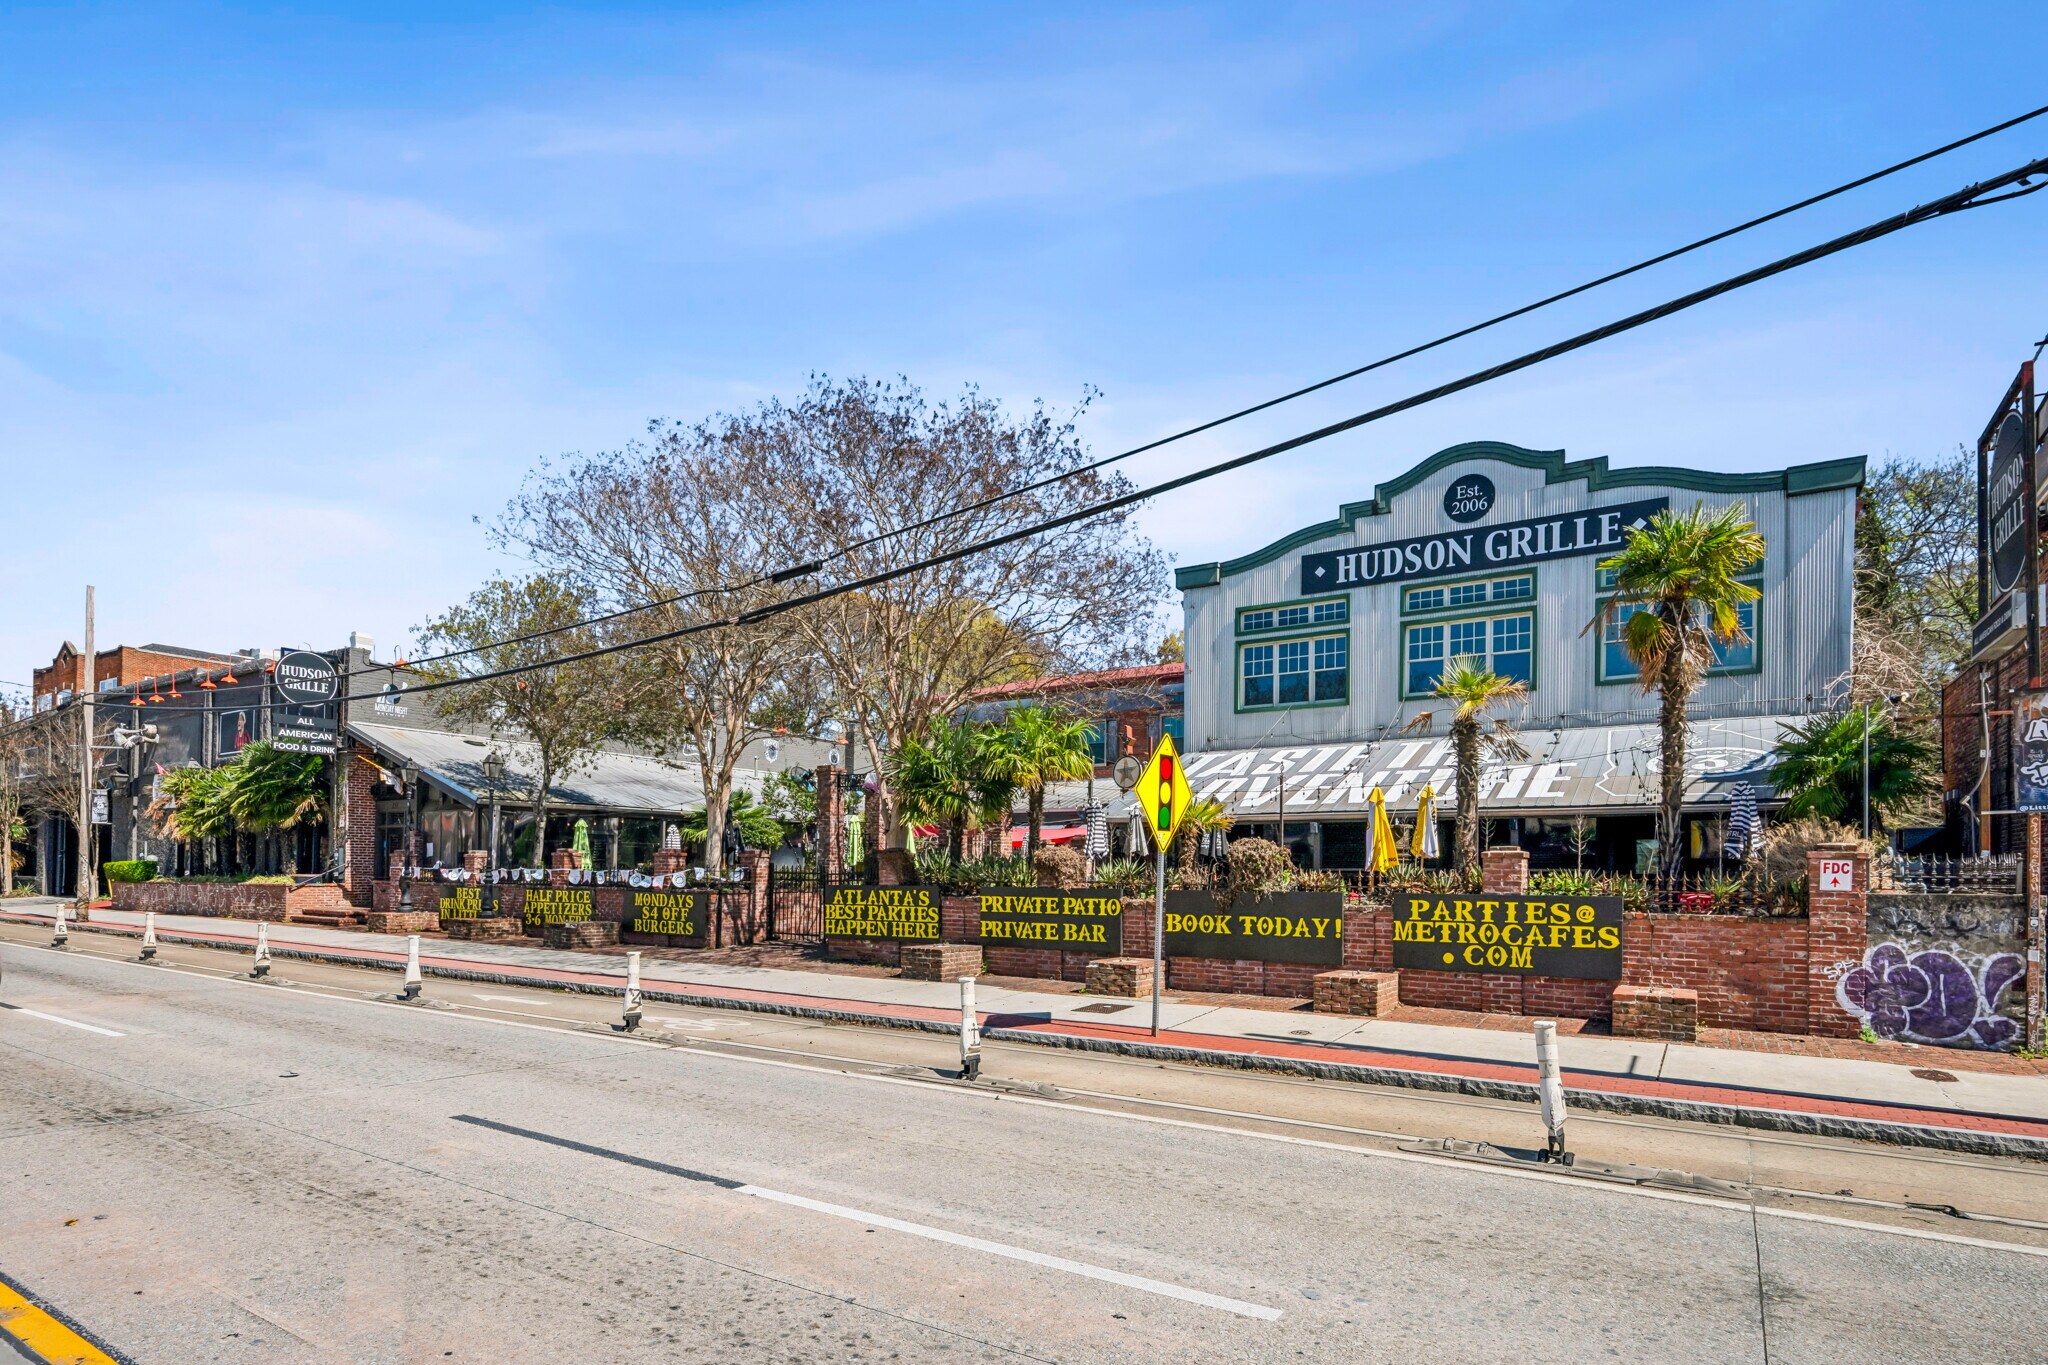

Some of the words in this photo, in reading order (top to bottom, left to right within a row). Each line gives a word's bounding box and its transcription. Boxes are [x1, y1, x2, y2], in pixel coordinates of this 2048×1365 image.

[1456, 485, 1483, 500] Est.
[1451, 496, 1488, 515] 2006
[1336, 534, 1474, 584] HUDSON
[1484, 512, 1622, 561] GRILLE
[281, 664, 332, 682] HUDSON
[284, 678, 329, 694] GRILLE
[297, 717, 315, 726] ALL
[279, 729, 333, 741] AMERICAN
[273, 742, 300, 751] FOOD
[301, 744, 309, 752] &
[309, 745, 336, 754] DRINK
[1822, 862, 1850, 875] FDC
[456, 887, 481, 899] BEST
[525, 889, 553, 901] HALF
[555, 890, 591, 903] PRICE
[634, 892, 694, 908] MONDAYS
[832, 889, 930, 906] ATLANTA'S
[440, 897, 465, 910] DRINK
[467, 898, 499, 912] PRIS
[523, 901, 592, 916] APPETIZERS
[980, 895, 1059, 915] PRIVATE
[1062, 897, 1121, 916] PATIO
[441, 908, 450, 920] IN
[662, 907, 689, 921] OFF
[825, 904, 865, 920] BEST
[867, 905, 939, 922] PARTIES
[634, 918, 694, 935] BURGERS
[825, 919, 888, 936] HAPPEN
[891, 921, 939, 938] HERE
[980, 920, 1059, 940] PRIVATE
[1063, 923, 1107, 942] BAR
[1165, 913, 1232, 934] BOOK
[1238, 915, 1342, 939] TODAY!
[1392, 920, 1620, 949] METROCAFES
